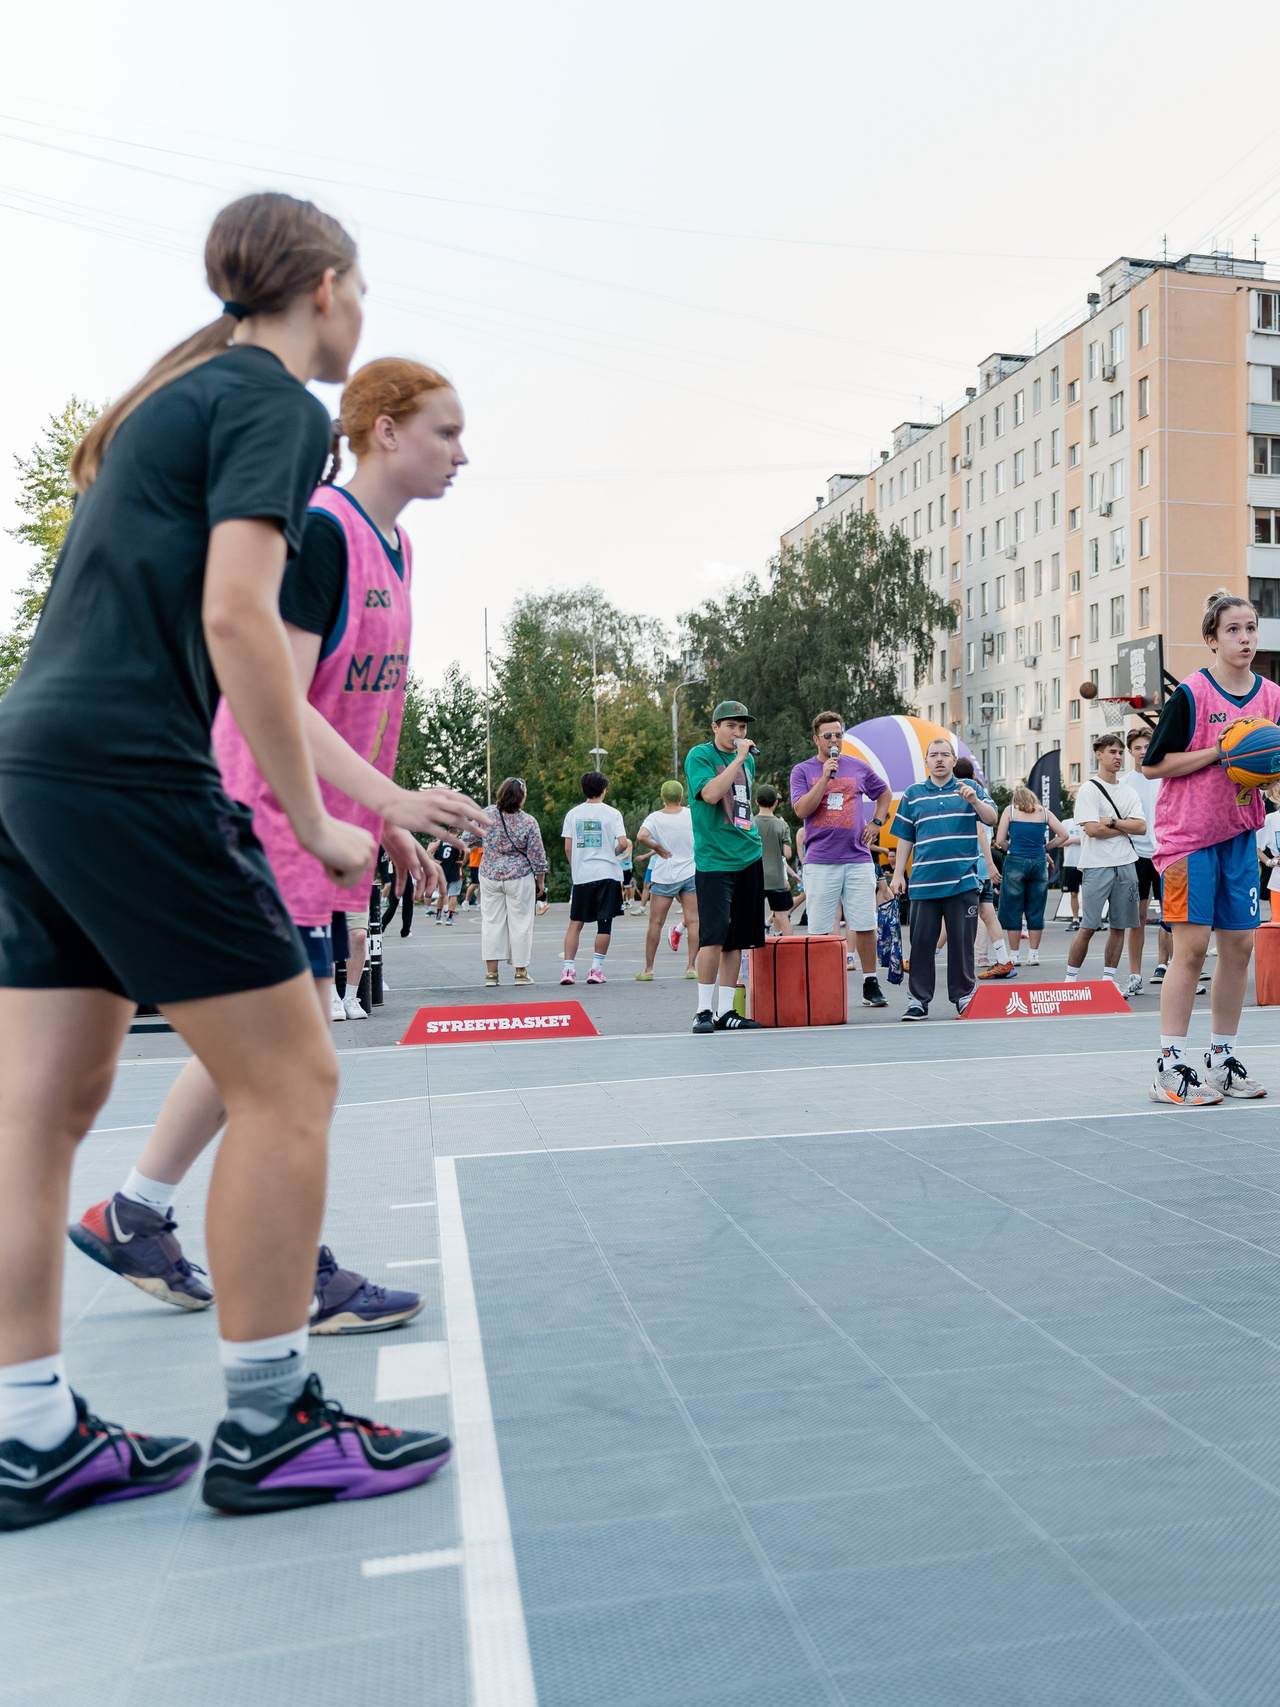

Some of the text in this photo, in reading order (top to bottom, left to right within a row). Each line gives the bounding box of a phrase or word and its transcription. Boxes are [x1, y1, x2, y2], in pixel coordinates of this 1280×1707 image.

[342, 653, 408, 692] MAS
[442, 846, 452, 859] 6
[1249, 887, 1258, 916] 3
[1029, 986, 1092, 1003] МОСКОВСКИЙ
[427, 1005, 571, 1034] STREETBASKET
[1031, 1002, 1060, 1014] СПОРТ
